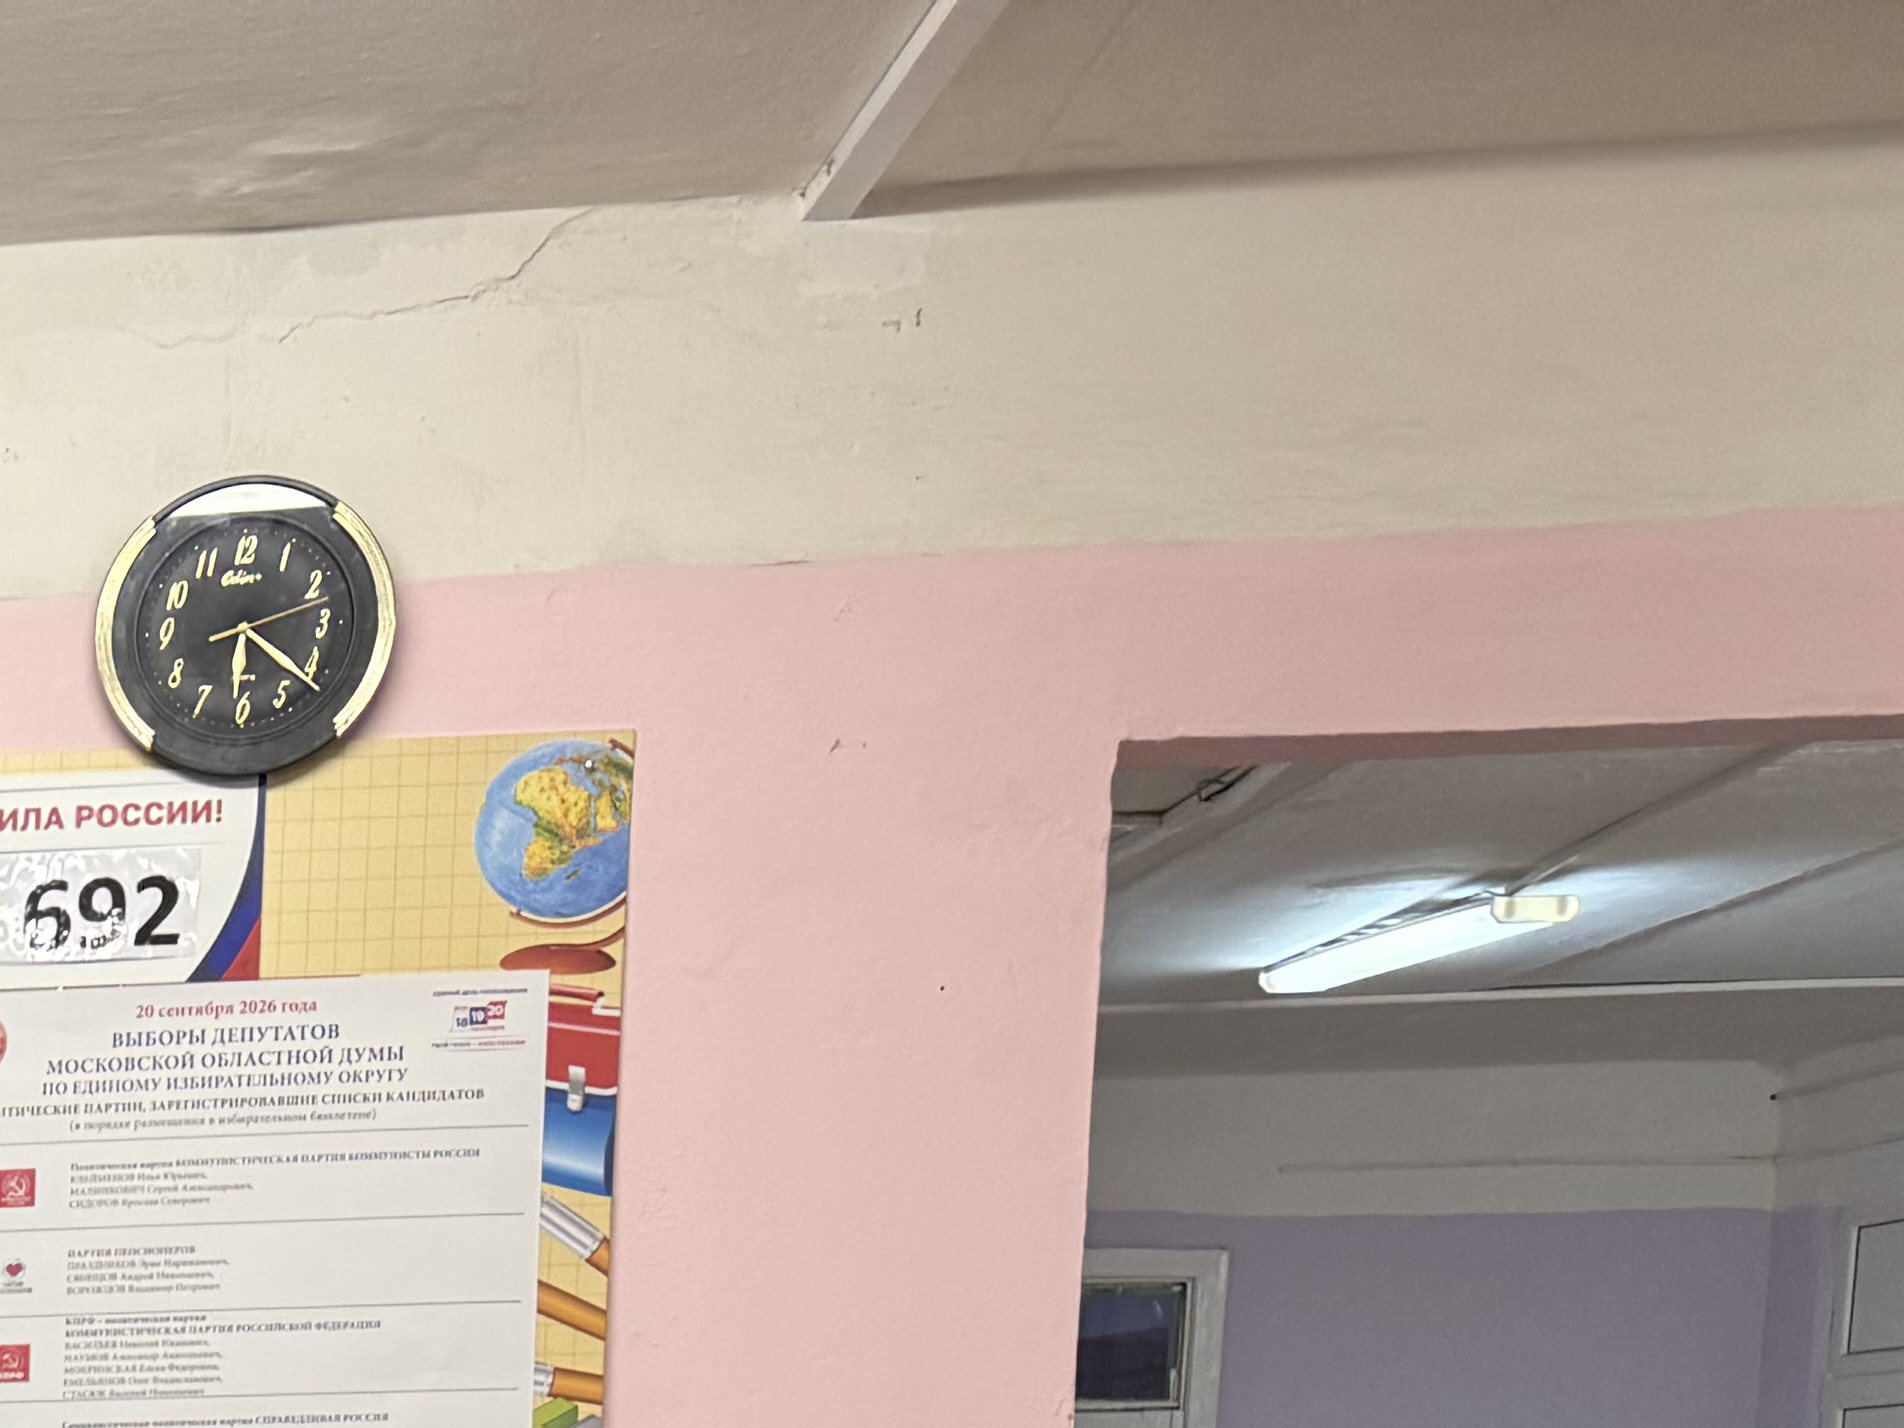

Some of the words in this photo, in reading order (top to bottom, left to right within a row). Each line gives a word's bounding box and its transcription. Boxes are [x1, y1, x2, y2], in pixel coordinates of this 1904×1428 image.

[196, 548, 217, 578] 11
[234, 535, 258, 565] 12
[280, 543, 290, 571] 1
[167, 581, 188, 611] 10
[305, 570, 322, 599] 2
[160, 617, 174, 650] 9
[316, 609, 330, 638] 3
[169, 659, 184, 688] 8
[304, 646, 319, 680] 4
[193, 686, 212, 718] 7
[235, 692, 250, 725] 6
[273, 680, 290, 709] 5
[74, 799, 222, 827] РОССИИ!
[23, 874, 181, 950] 692
[135, 1004, 154, 1018] 20
[158, 1001, 234, 1019] сентября
[239, 999, 277, 1014] 2026
[281, 1001, 317, 1013] года
[112, 1028, 205, 1047] ВЫБОРЫ
[210, 1023, 339, 1045] ДЕПУТАТОВ
[46, 1051, 194, 1074] МОСКОВСКОЙ
[200, 1045, 333, 1067] ОБЛАСТНОЙ
[337, 1045, 403, 1065] ДУМЫ
[42, 1082, 67, 1095] ПО
[72, 1077, 161, 1094] ЕДИНОМУ
[166, 1071, 333, 1089] ИЗБИРАТЕЛЬНОМУ
[337, 1067, 407, 1083] ОКРУГУ
